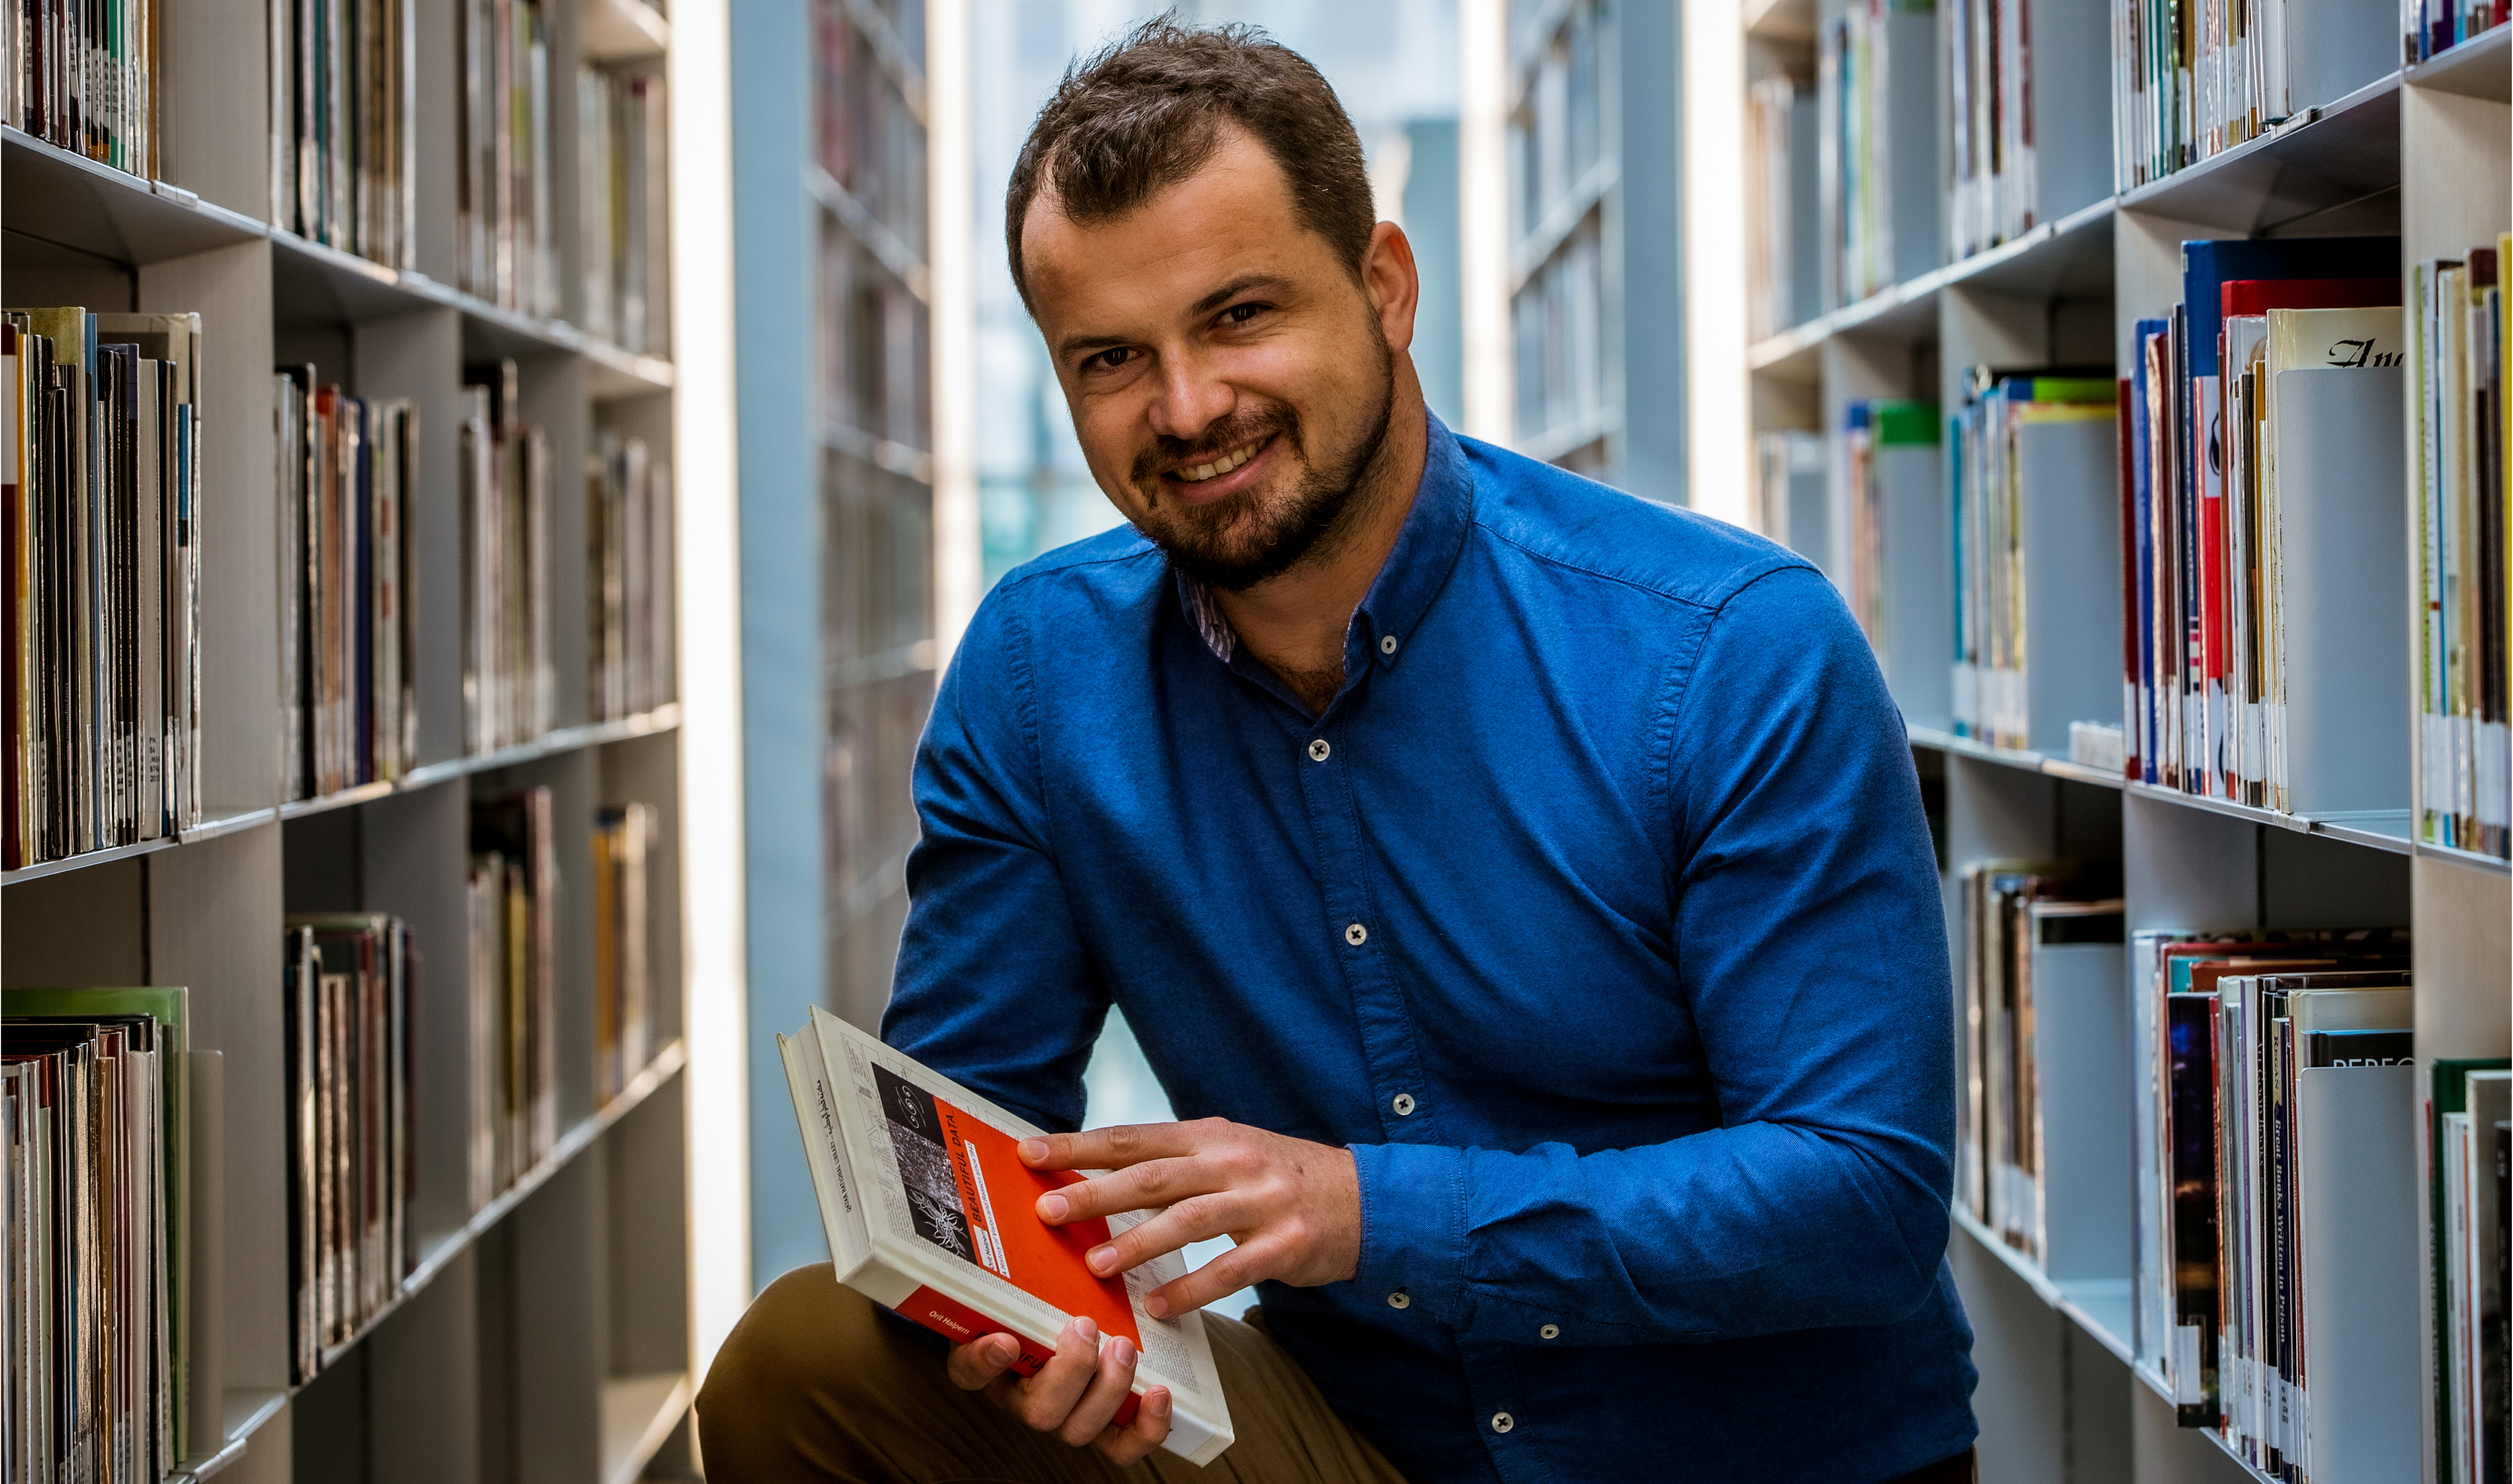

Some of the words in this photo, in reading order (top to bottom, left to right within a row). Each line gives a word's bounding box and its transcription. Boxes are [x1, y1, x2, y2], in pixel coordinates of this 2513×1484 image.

[830, 1141, 839, 1165] LIBRARY
[836, 1164, 847, 1194] NATIONAL
[956, 1152, 981, 1223] BEAUTIFUL
[978, 1177, 988, 1202] Reason
[843, 1192, 851, 1213] QATAR
[988, 1216, 997, 1236] Vision
[993, 1236, 999, 1246] of
[997, 1244, 1006, 1270] History
[2279, 1275, 2284, 1290] in
[929, 1310, 943, 1322] Orit
